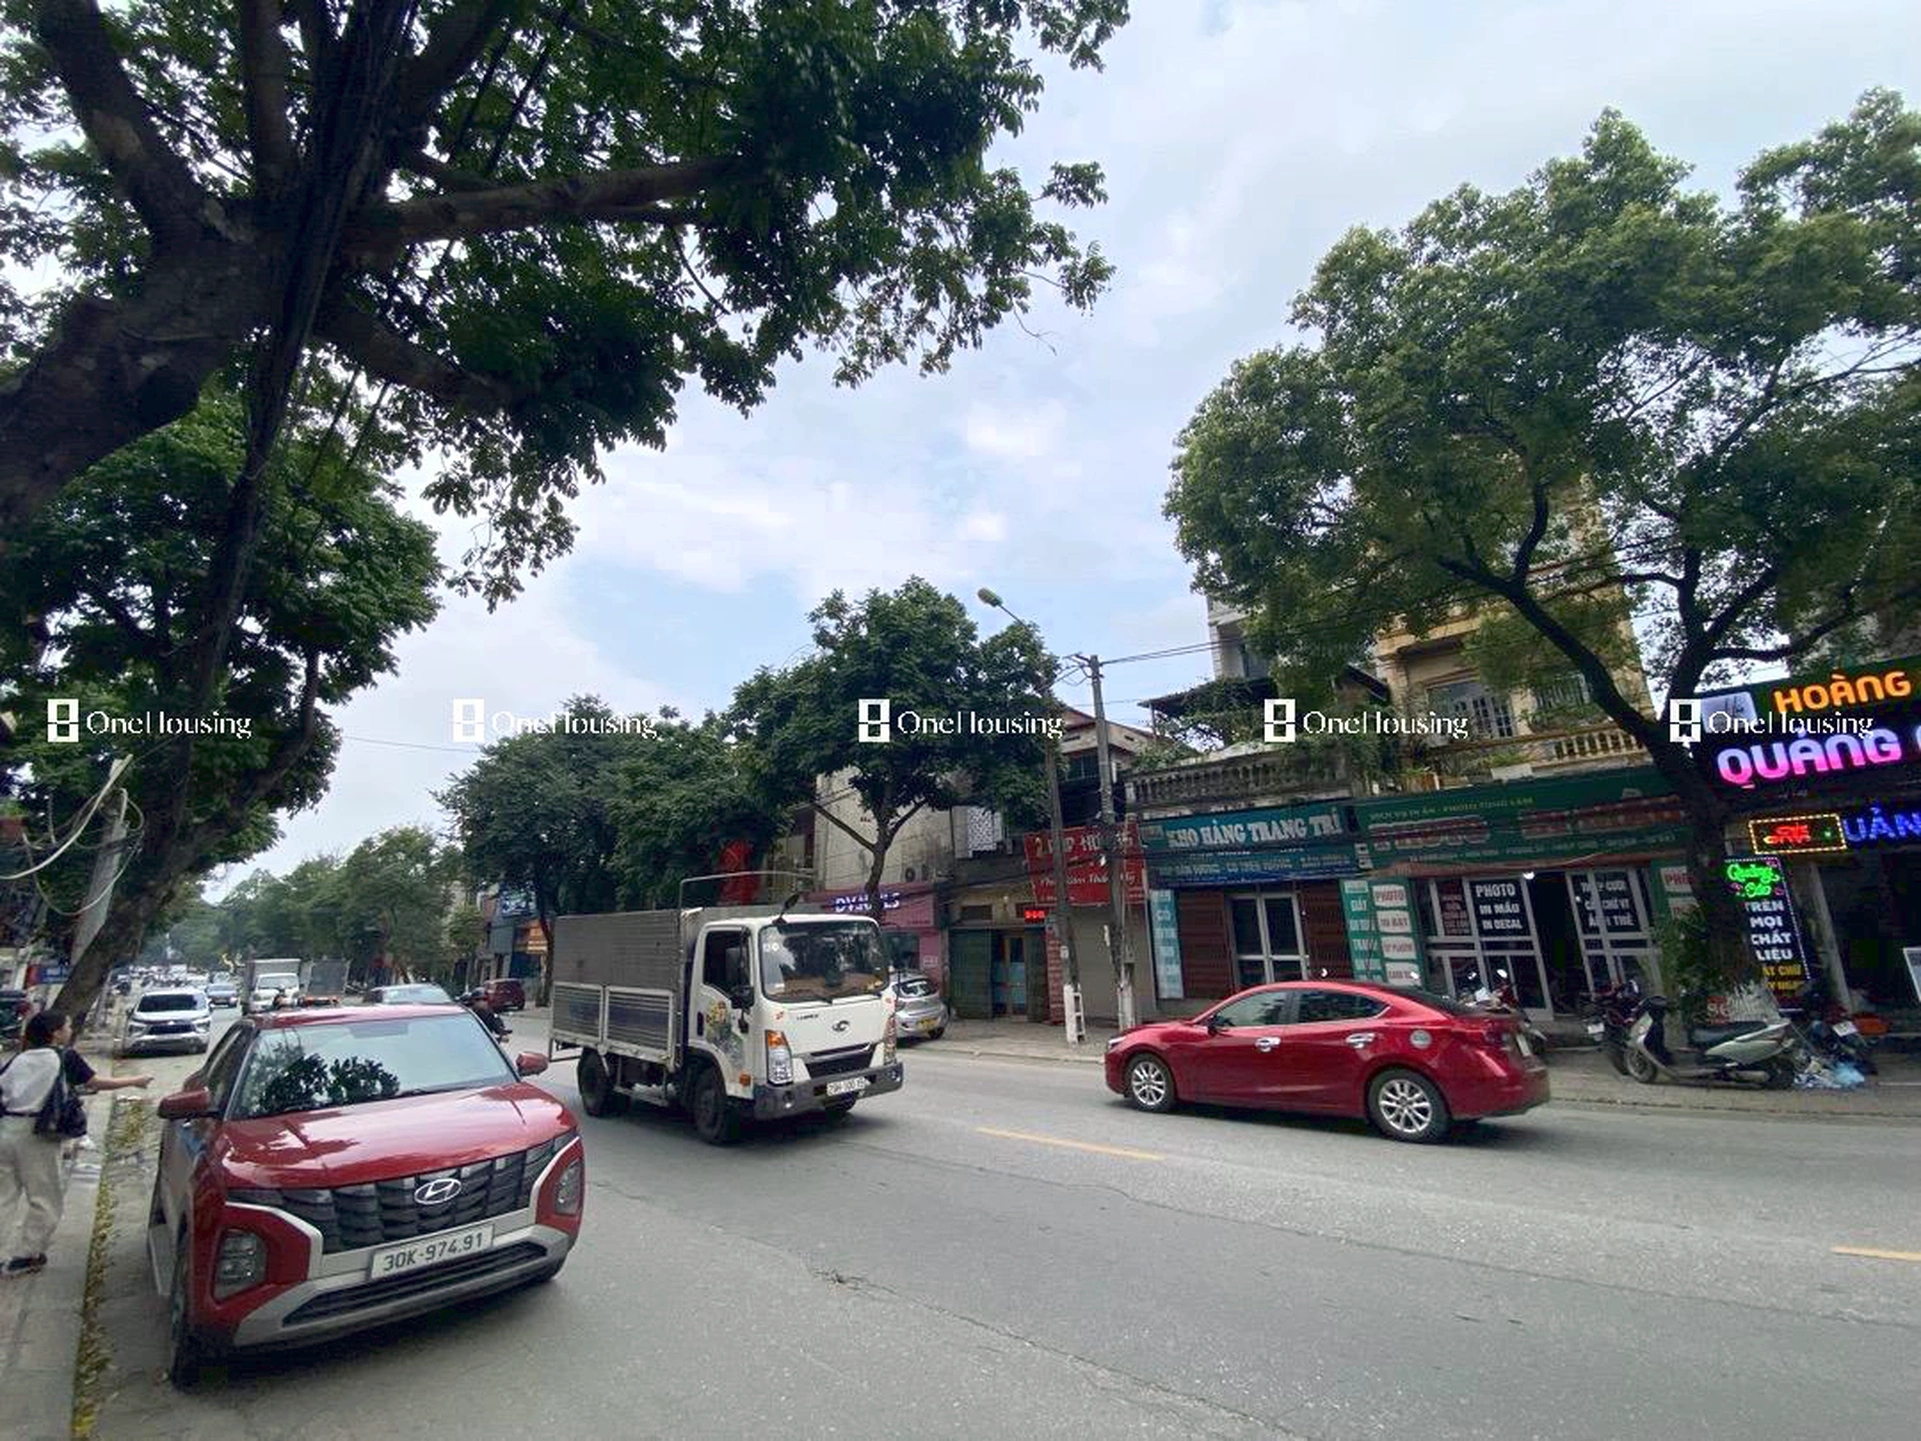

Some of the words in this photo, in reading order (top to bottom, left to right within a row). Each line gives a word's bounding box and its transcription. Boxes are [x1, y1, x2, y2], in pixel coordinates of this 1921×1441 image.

[1773, 670, 1912, 713] HOÀNG
[1716, 727, 1902, 789] QUẢNG
[1167, 826, 1199, 848] KHO
[1201, 818, 1247, 846] HÀNG
[1246, 817, 1308, 843] TRANG
[1475, 883, 1516, 898] PHOTO
[1749, 915, 1783, 929] MỌI
[1750, 928, 1792, 945] CHẤT
[1755, 946, 1793, 962] LIỆU
[383, 1232, 483, 1272] 30K-974.91
